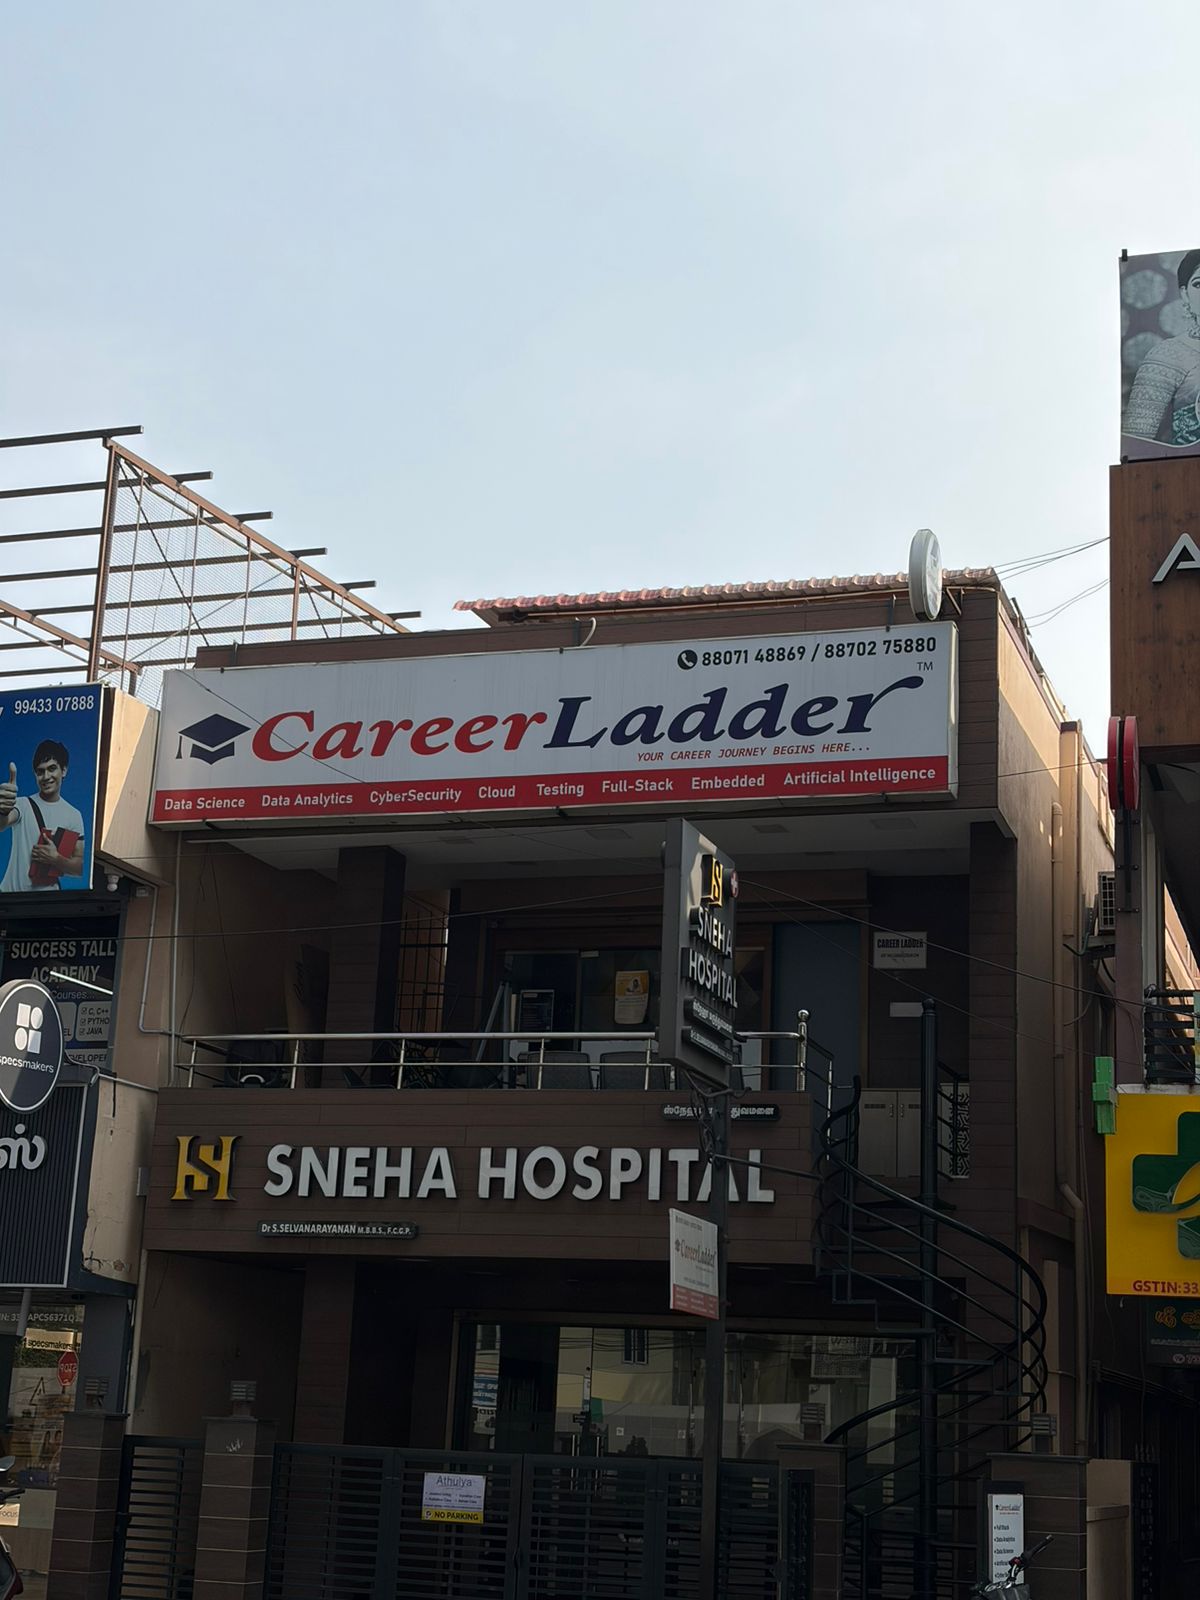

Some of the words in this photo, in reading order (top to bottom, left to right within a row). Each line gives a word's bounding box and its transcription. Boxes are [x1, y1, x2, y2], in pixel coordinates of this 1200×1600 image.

[702, 650, 749, 666] 88071
[754, 645, 806, 663] 48869
[811, 643, 820, 662] /
[825, 641, 877, 659] 88702
[883, 637, 937, 655] 75880
[917, 662, 934, 671] TM
[14, 698, 52, 714] 99433
[56, 695, 94, 711] 07888
[637, 751, 664, 763] YOUR
[670, 750, 711, 761] CAREER
[718, 747, 767, 758] JOURNEY
[773, 744, 815, 756] BEGINS
[822, 743, 870, 753] HERE...
[691, 774, 765, 790] Embedded
[783, 770, 845, 786] Artificial
[850, 767, 936, 784] Intelligence
[478, 785, 516, 799] Cloud
[536, 782, 584, 797] Testing
[602, 778, 673, 793] Full-Stack
[164, 798, 193, 810] Data
[196, 796, 246, 809] Science
[261, 794, 291, 807] Data
[294, 792, 353, 808] Analytics
[369, 788, 462, 805] CyberSecurity
[698, 905, 733, 958] SNEHA
[10, 940, 77, 959] SUCCESS
[30, 965, 101, 983] ACADEMY
[689, 948, 738, 1008] HOSPITAL
[86, 1027, 103, 1036] JAVA
[263, 1144, 457, 1199] SNEHA
[261, 1223, 271, 1233] Dr
[436, 1475, 473, 1488] Athulya
[434, 1511, 446, 1519] NO
[446, 1511, 479, 1521] PARKING
